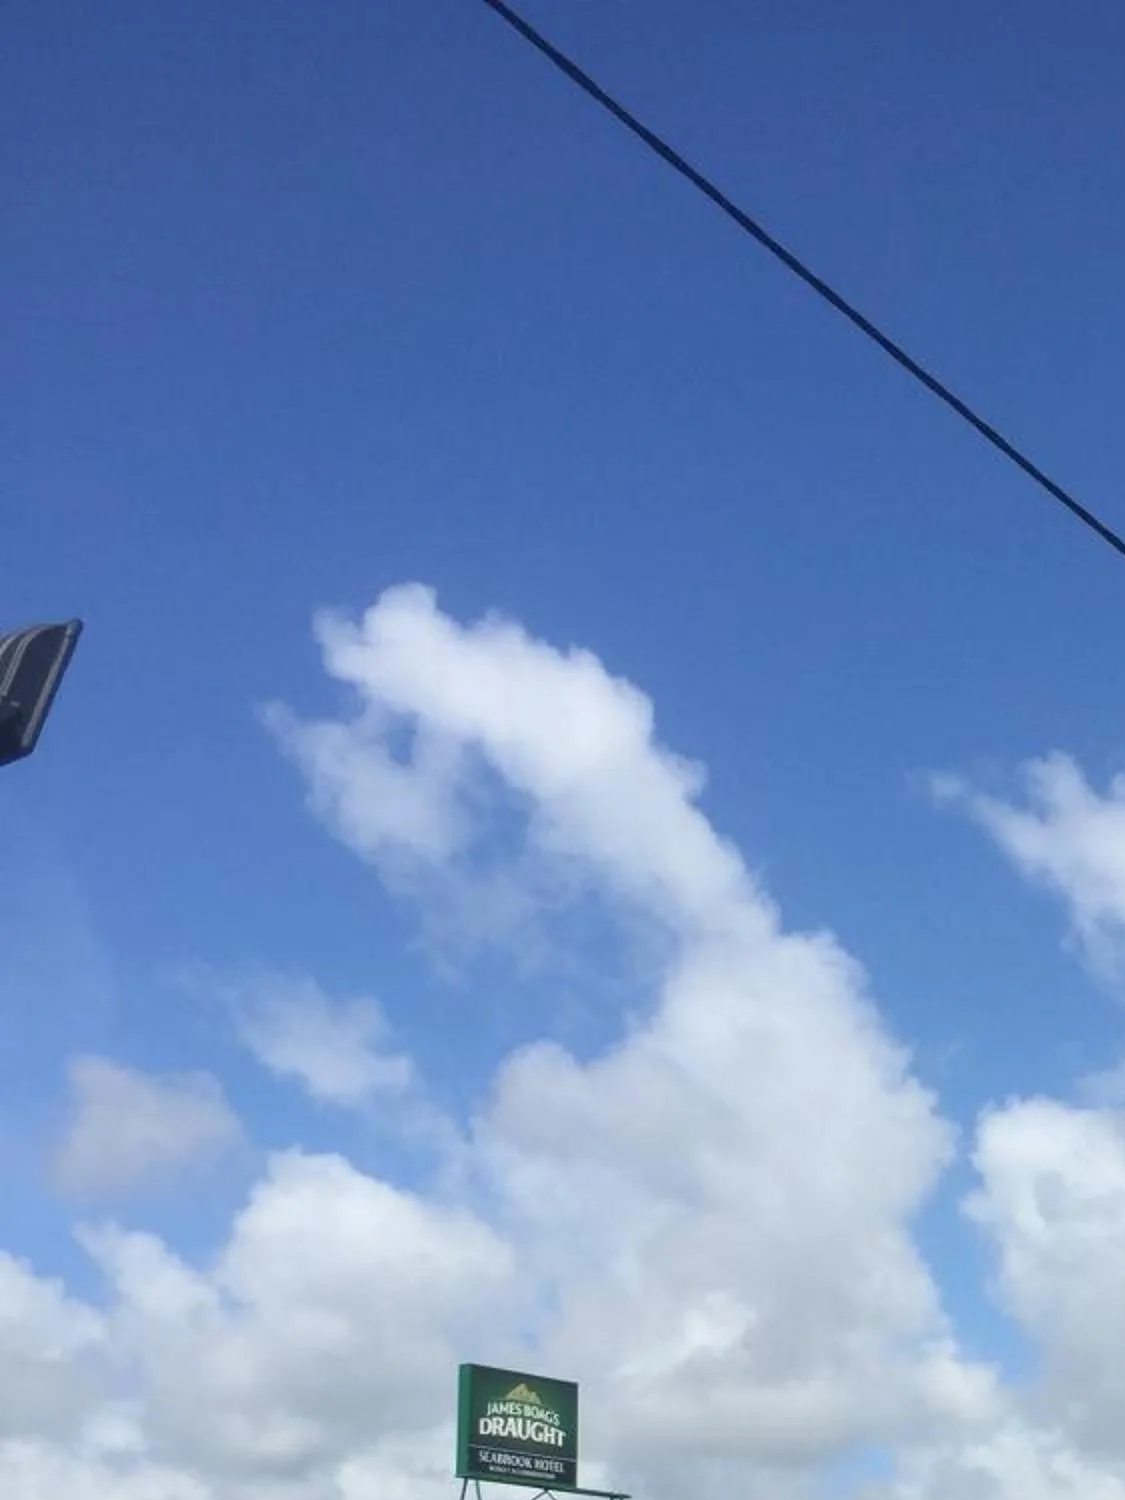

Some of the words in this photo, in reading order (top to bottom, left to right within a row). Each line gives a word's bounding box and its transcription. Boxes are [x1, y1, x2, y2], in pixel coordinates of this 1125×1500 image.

[487, 1401, 522, 1416] JAMES
[479, 1417, 567, 1447] DRAUGHT
[534, 1458, 565, 1473] HOTEL
